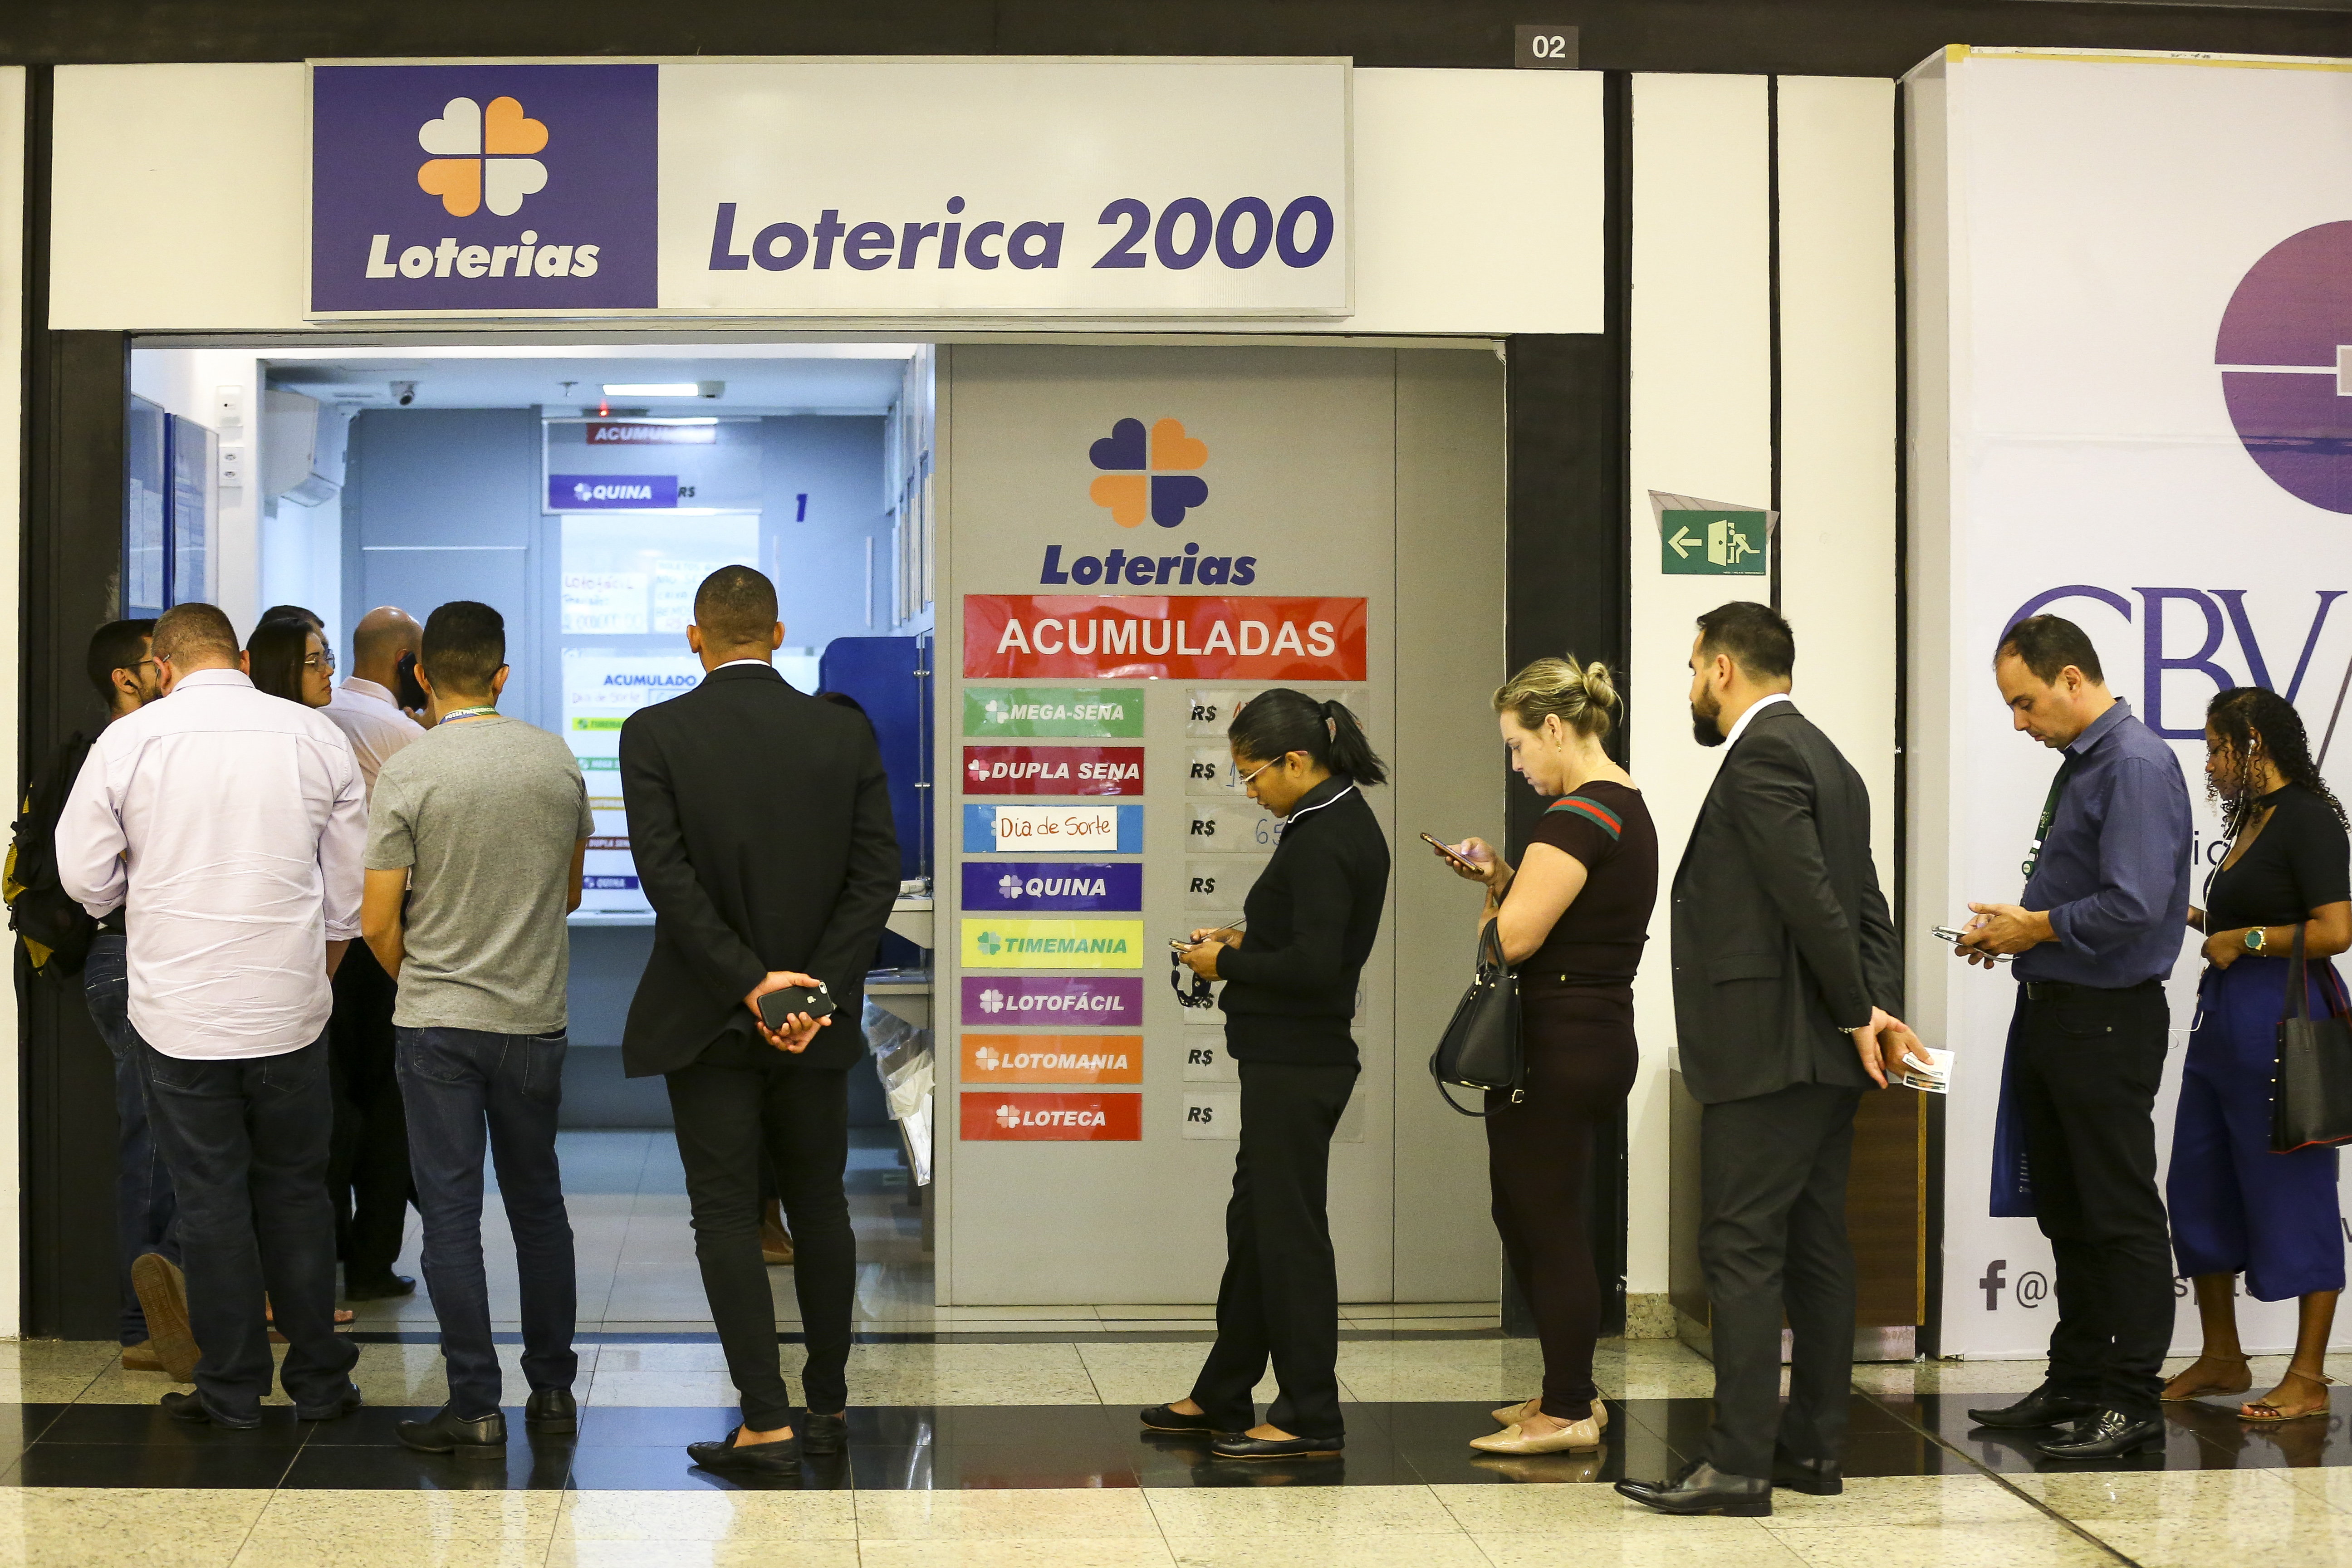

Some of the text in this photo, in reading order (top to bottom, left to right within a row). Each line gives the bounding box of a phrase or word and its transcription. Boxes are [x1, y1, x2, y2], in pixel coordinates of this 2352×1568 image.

[1532, 35, 1565, 58] 02
[708, 195, 1334, 272] Loterica 2000
[365, 230, 600, 279] Loterias
[593, 485, 652, 500] QUINA
[796, 493, 808, 522] 1
[1040, 542, 1257, 586] Loterias
[996, 619, 1335, 657] ACUMULADAS
[603, 675, 697, 686] ACUMULADO
[445, 711, 462, 720] POSSE
[1010, 703, 1124, 720] MEGA-SENA
[1191, 706, 1217, 723] R$
[992, 762, 1139, 779] DUPLA SENA
[1190, 763, 1215, 780] R$
[1001, 815, 1111, 838] Dia de Sorte
[1190, 820, 1215, 837] R$
[1025, 878, 1106, 898] QUINA
[1190, 877, 1215, 895] R$
[1005, 938, 1127, 954] TIMEMANIA
[1006, 992, 1124, 1011] LOTOFÁCIL
[1001, 1053, 1127, 1070] LOTOMANIA
[1188, 1049, 1213, 1066] R$
[1023, 1111, 1106, 1126] LOTECA
[1187, 1107, 1213, 1124] R$
